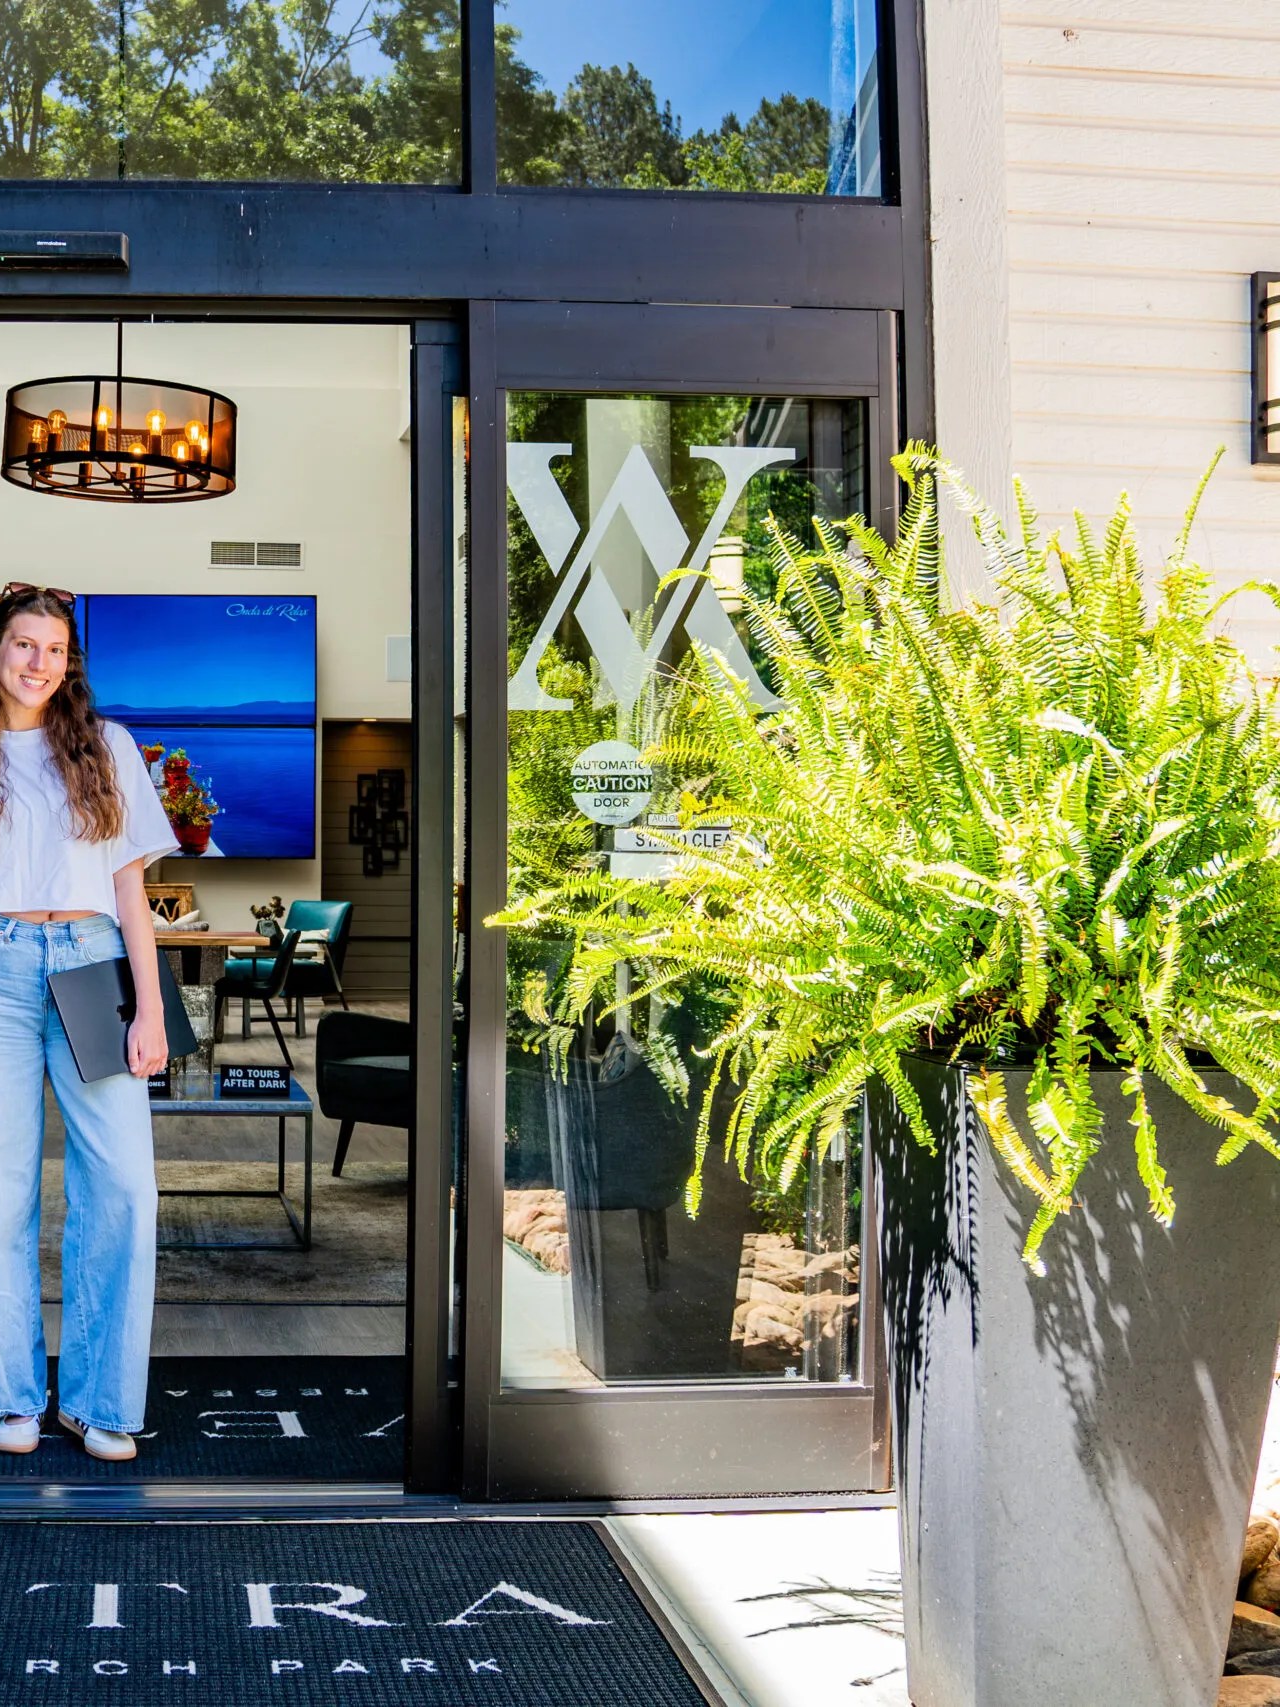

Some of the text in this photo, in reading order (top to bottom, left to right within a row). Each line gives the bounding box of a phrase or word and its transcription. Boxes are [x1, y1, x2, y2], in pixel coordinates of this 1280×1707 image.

[572, 777, 649, 791] CAUTION
[593, 797, 630, 808] DOOR
[229, 1068, 281, 1079] NO TOURS
[223, 1078, 287, 1089] AFTER DARK
[271, 1657, 503, 1675] PARK
